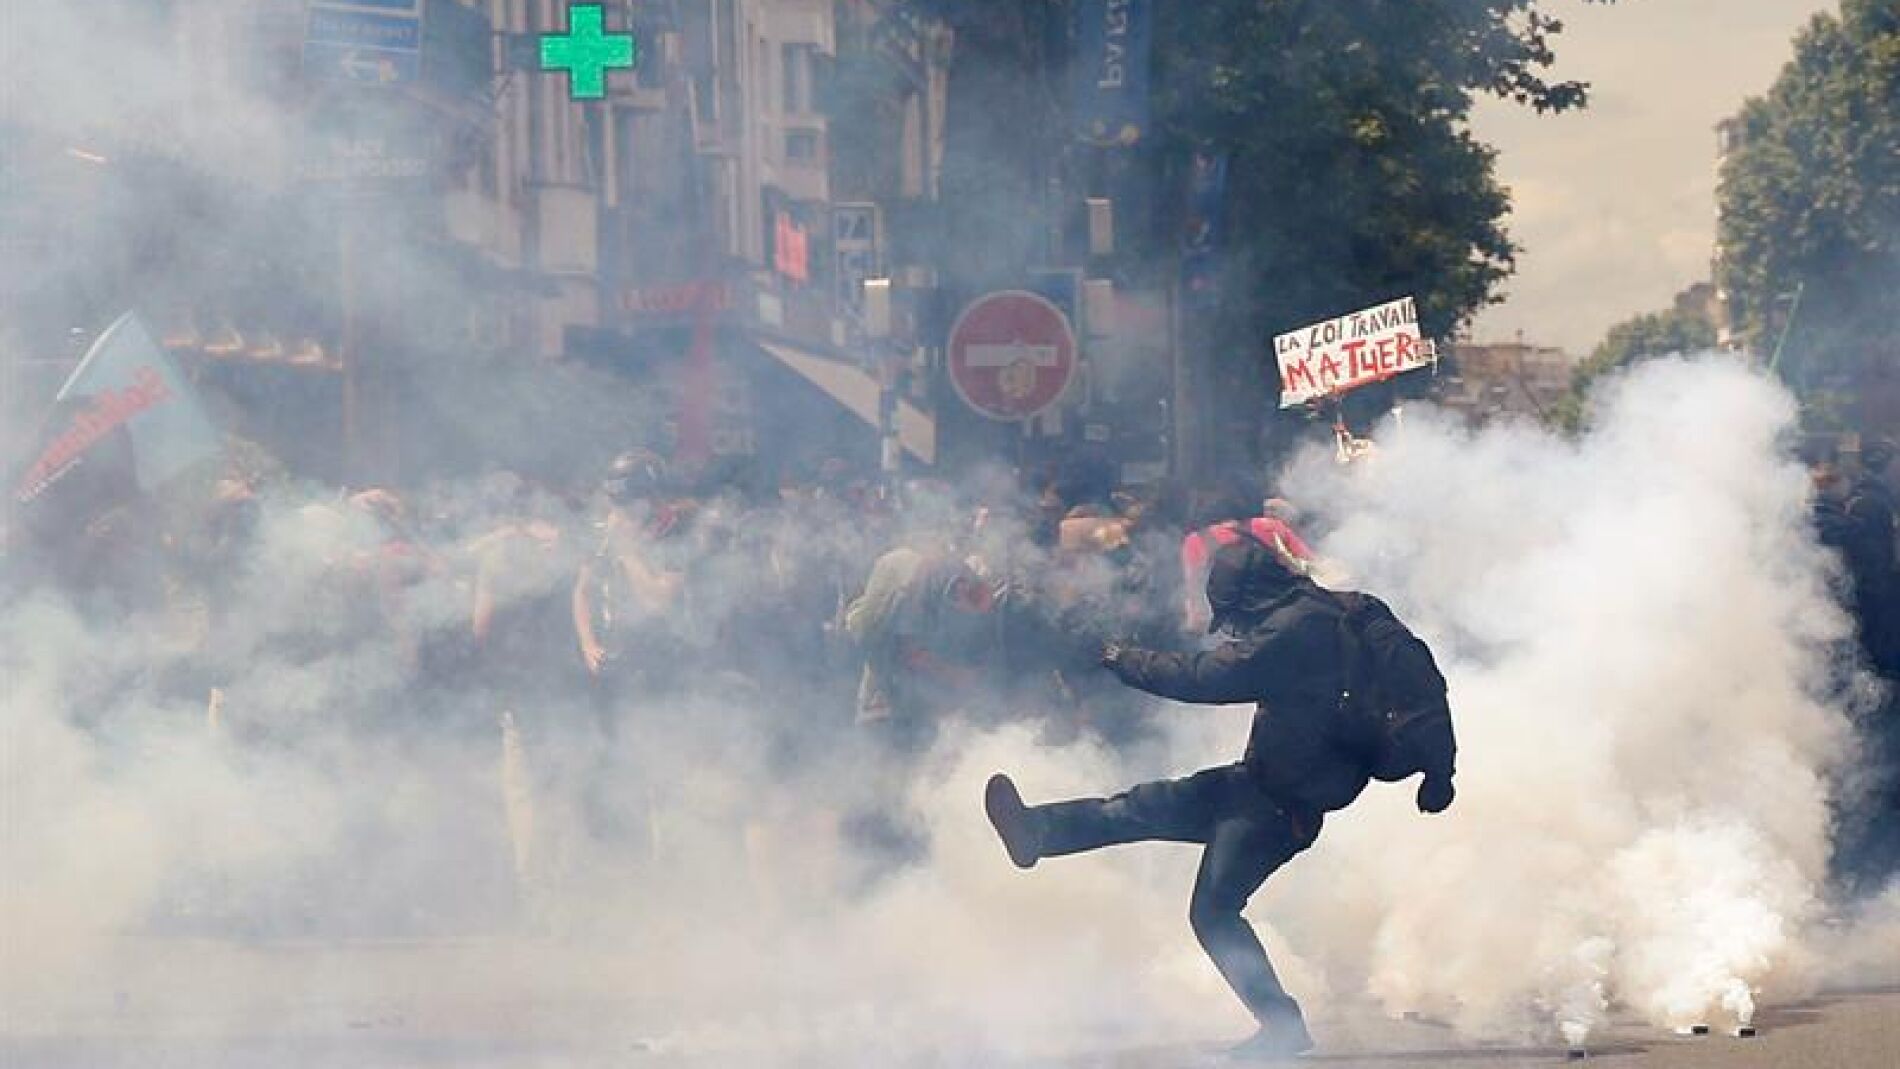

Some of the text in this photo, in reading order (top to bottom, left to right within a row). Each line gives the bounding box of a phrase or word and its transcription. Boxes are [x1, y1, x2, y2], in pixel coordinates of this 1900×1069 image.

[1279, 300, 1416, 354] LA LOI TRAVAIL
